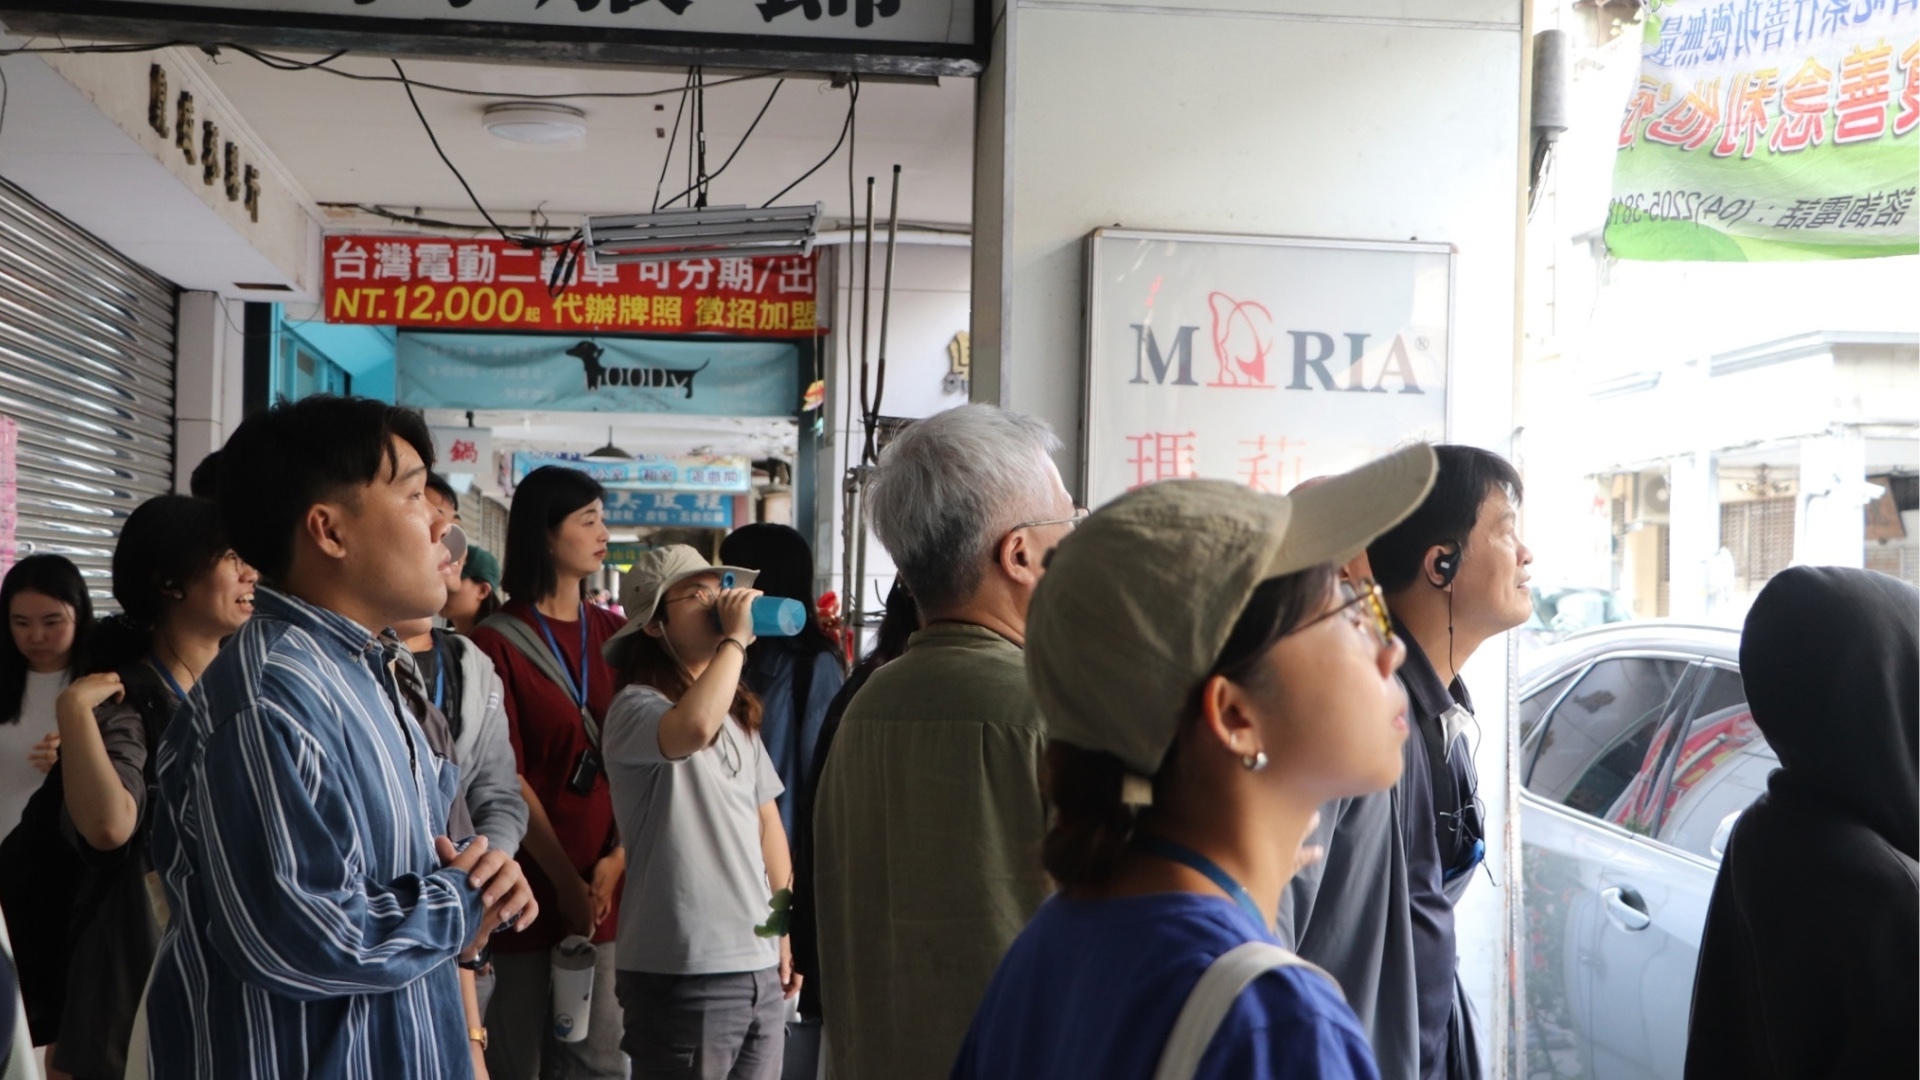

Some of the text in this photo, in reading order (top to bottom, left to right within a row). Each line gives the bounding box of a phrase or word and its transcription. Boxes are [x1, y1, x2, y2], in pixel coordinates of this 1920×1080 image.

[332, 242, 619, 288] 台灣電動二輪車
[552, 292, 683, 328] 代辦牌照
[695, 298, 818, 331] 徵招加盟
[449, 439, 479, 464] 鍋
